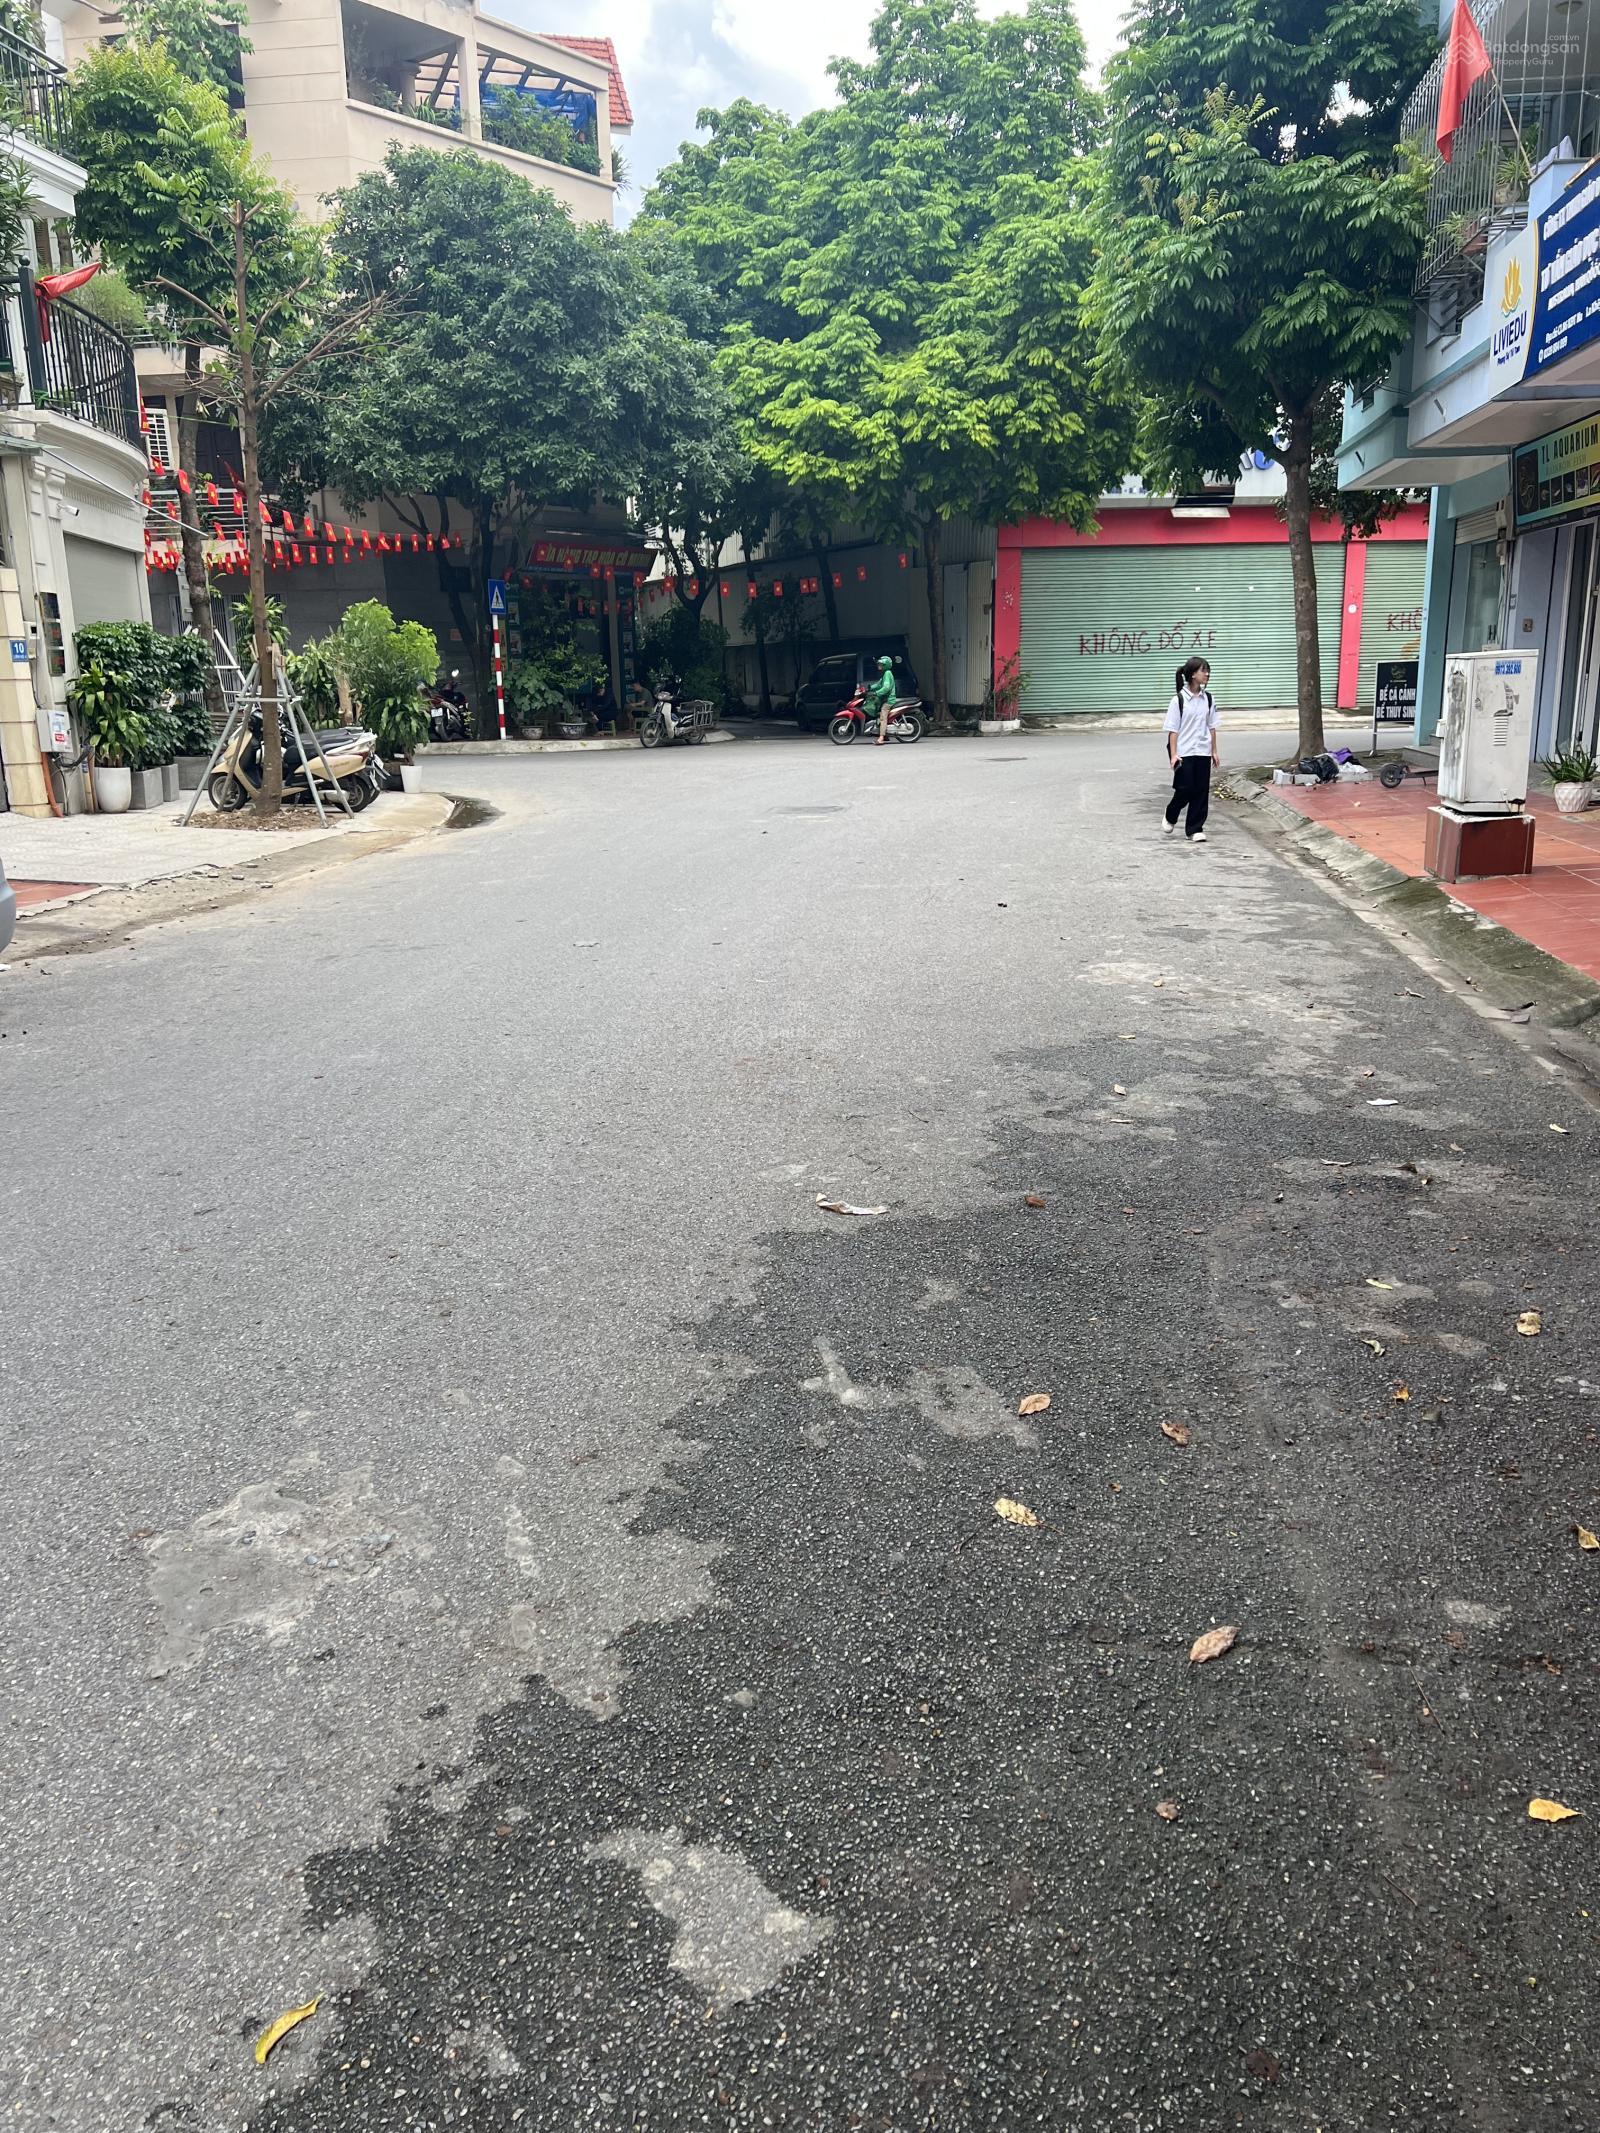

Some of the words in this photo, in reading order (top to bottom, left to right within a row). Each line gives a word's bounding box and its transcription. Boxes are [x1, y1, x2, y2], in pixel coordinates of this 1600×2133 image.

[1493, 310, 1527, 356] LIVIEDU
[1554, 423, 1599, 459] AQUARIUM
[13, 642, 25, 654] 10
[1078, 627, 1151, 656] KHÔNG
